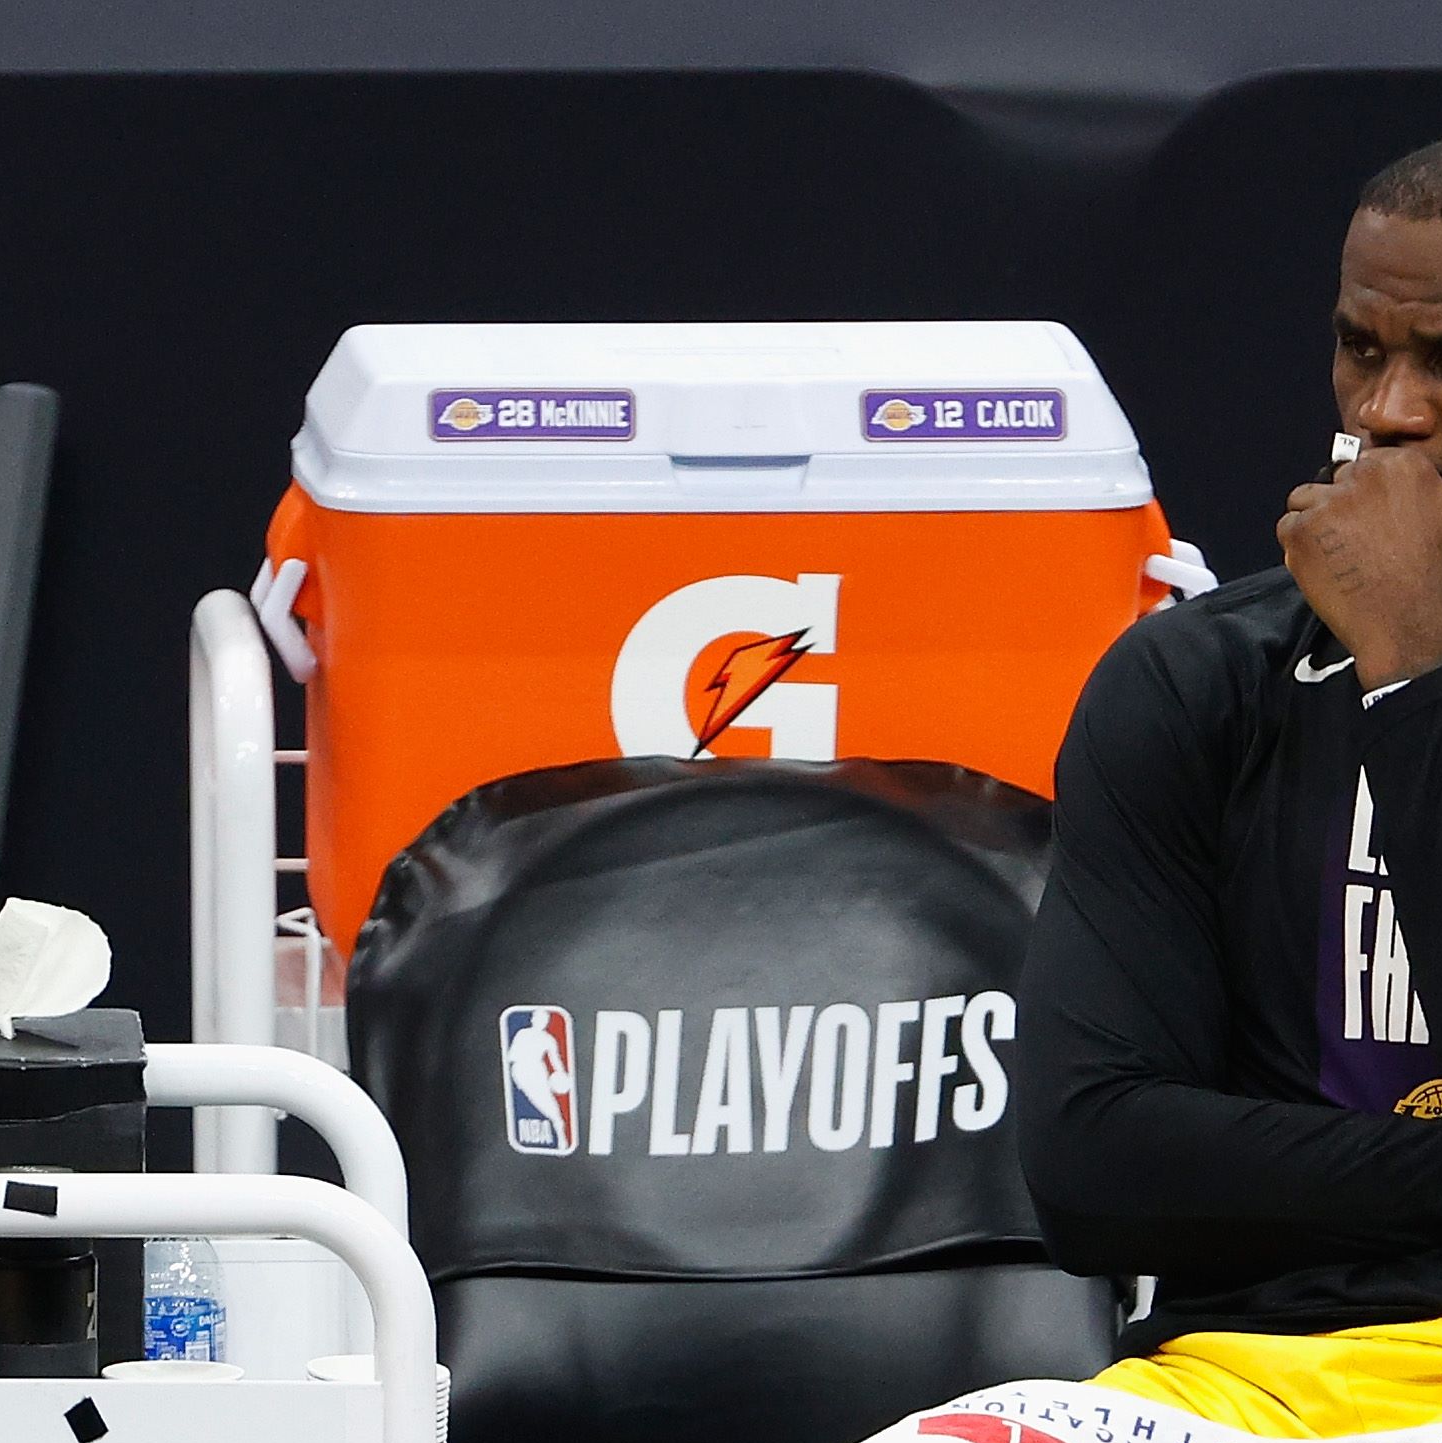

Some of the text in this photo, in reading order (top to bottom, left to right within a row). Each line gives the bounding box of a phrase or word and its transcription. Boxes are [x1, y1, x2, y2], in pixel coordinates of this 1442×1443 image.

[498, 400, 535, 427] 28
[540, 400, 630, 427] McKINNIE
[933, 400, 965, 428] 12
[976, 400, 1056, 428] CACOK
[610, 572, 843, 761] G
[588, 990, 1017, 1156] PLAYOFFS
